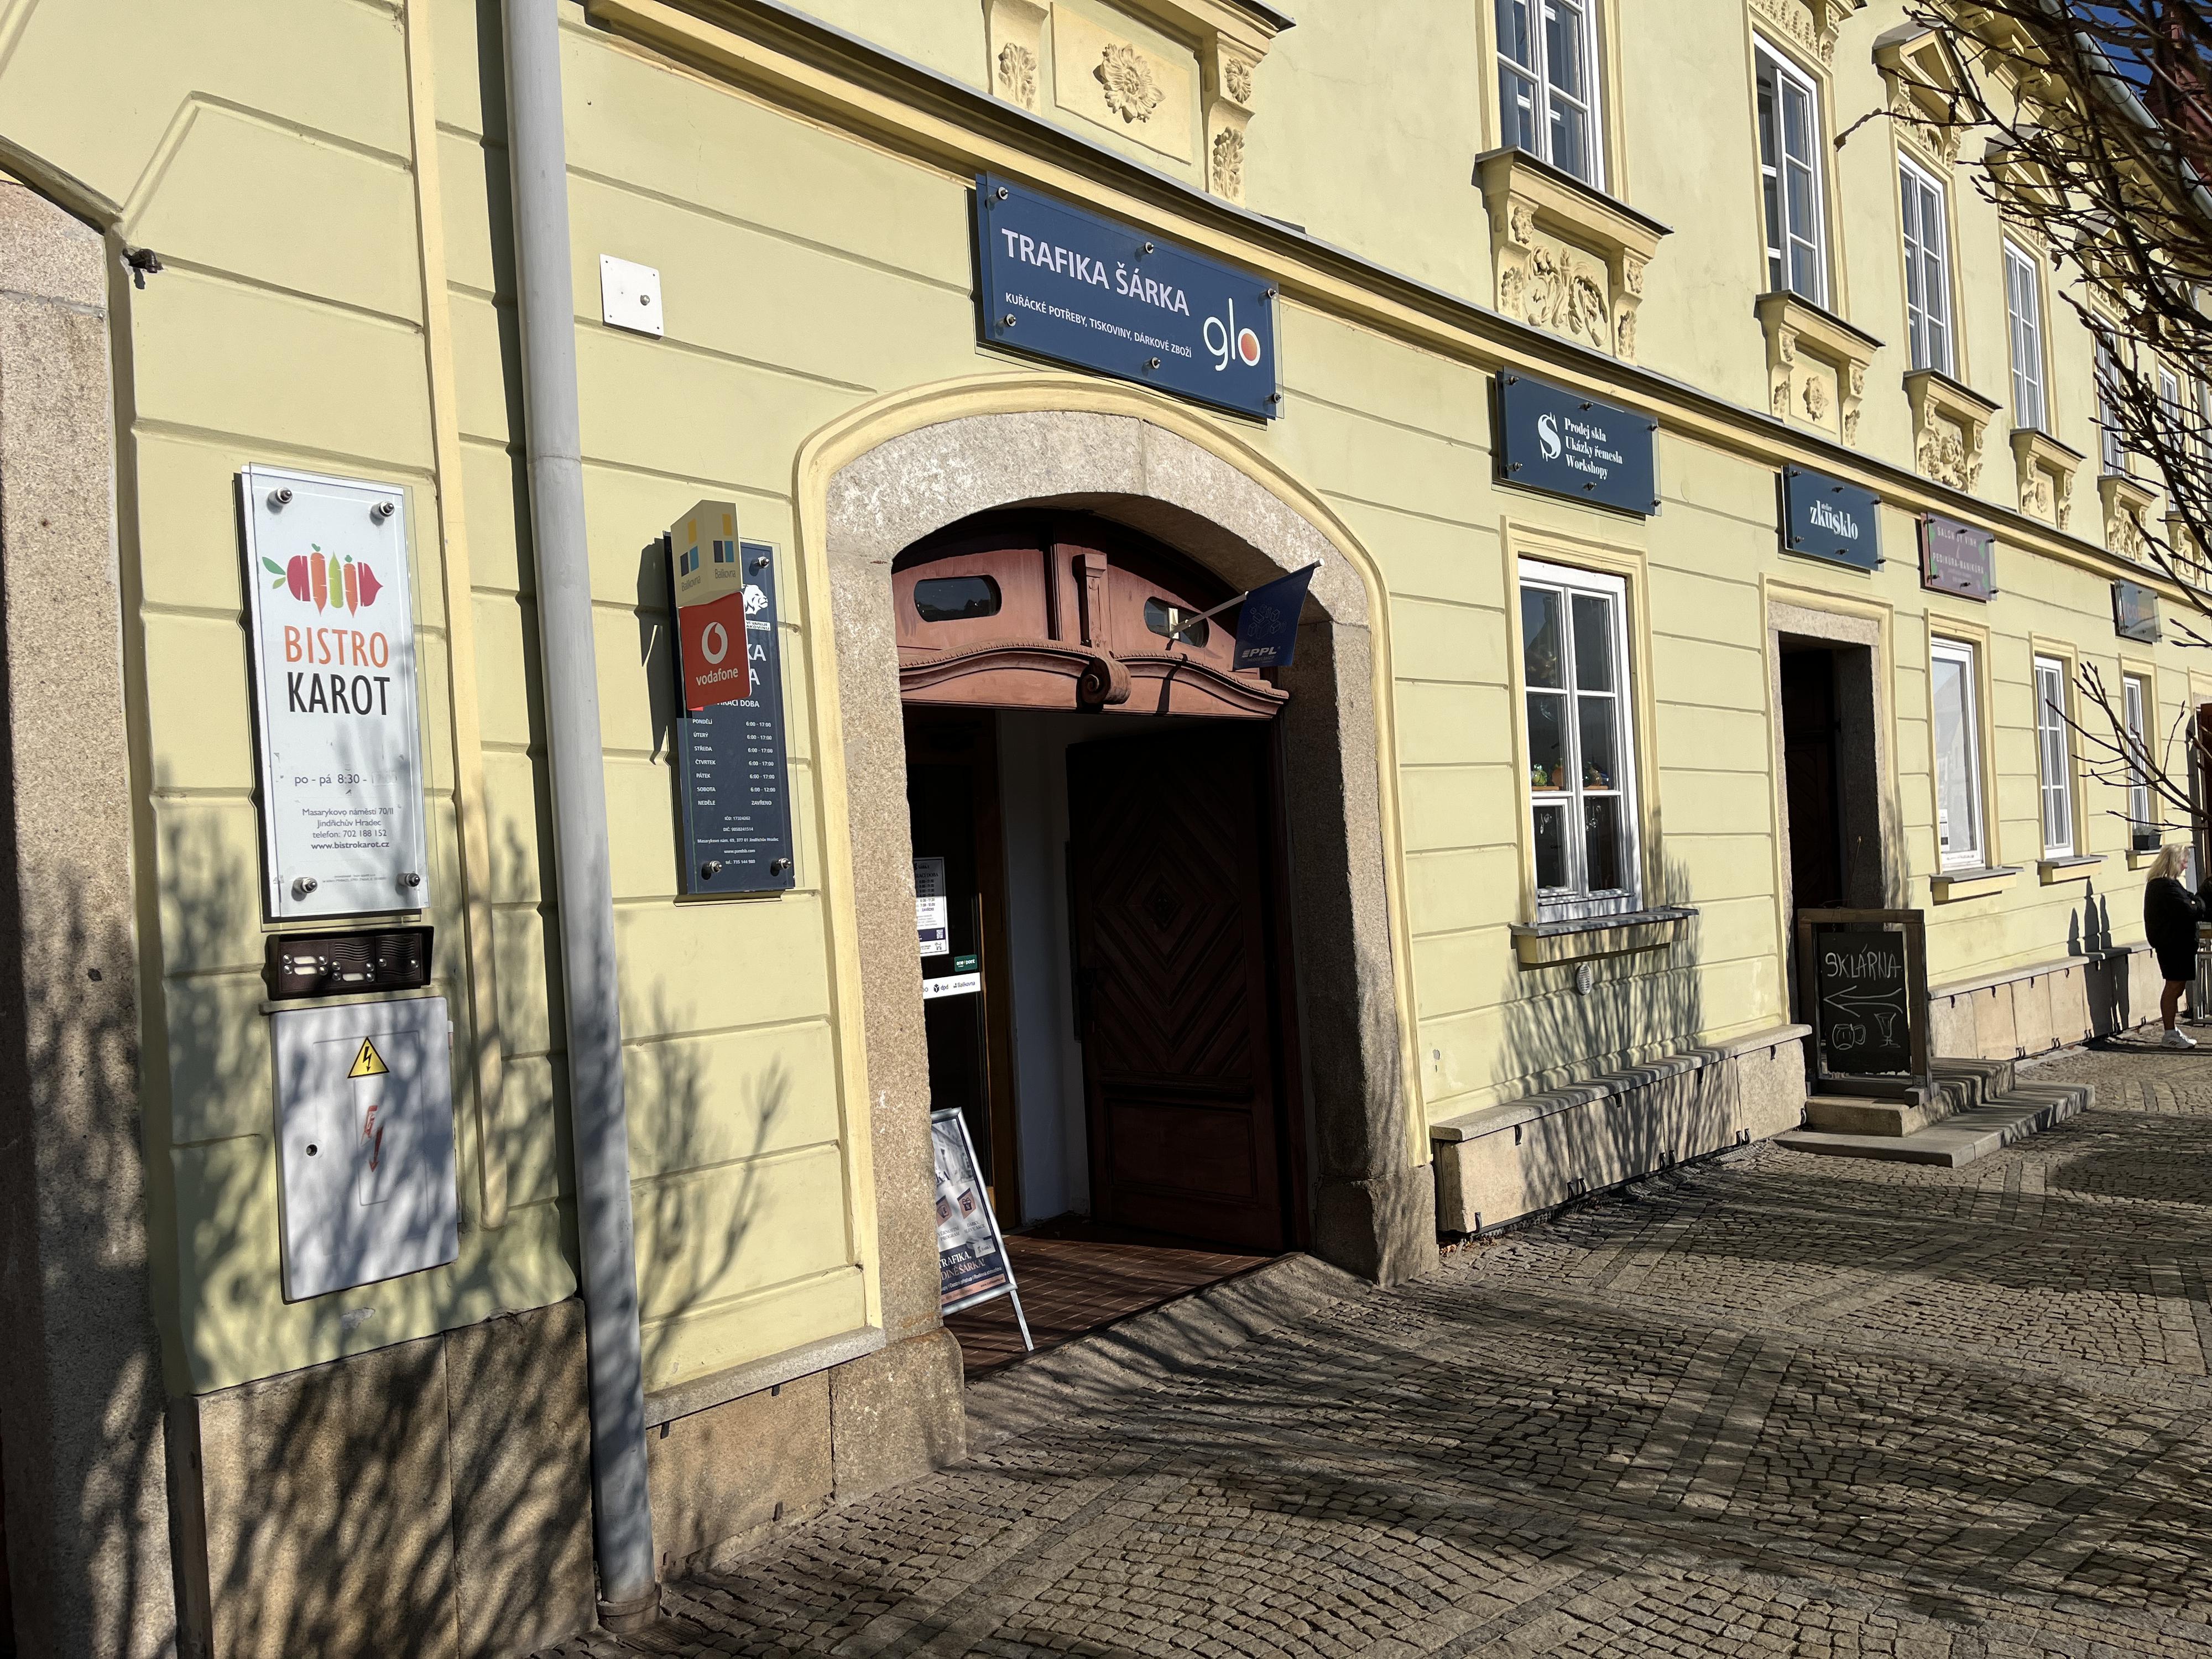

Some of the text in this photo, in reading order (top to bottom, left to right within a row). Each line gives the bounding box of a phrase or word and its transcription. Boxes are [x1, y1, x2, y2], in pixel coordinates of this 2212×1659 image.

[1001, 228, 1190, 316] TRAFIKA ŠÁRKA
[1005, 292, 1192, 358] KUŘÁCKÉ POTŘEBY, TISKOVINY, DÁRKOVÉ ZBOŽÍ
[1203, 298, 1261, 372] glo
[1564, 418, 1606, 442] Prodej skla
[1564, 435, 1623, 465] Ukázky řemesla
[1566, 454, 1609, 480] Workshopy
[1937, 526, 1954, 540] SALON
[284, 625, 388, 668] BISTRO
[696, 667, 738, 686] vodafone
[287, 671, 390, 716] KAROT
[740, 700, 760, 708] DOBA
[295, 776, 308, 786] po
[319, 774, 332, 786] pá
[337, 774, 359, 784] 8:30
[302, 808, 347, 817] Masarykovo
[317, 820, 353, 829] Jindřichův
[311, 841, 390, 849] www.bistrokarot.cz
[1825, 943, 1902, 981] SKLÁRNA
[940, 1232, 960, 1241] PROGRAM
[941, 1258, 985, 1280] DINĚ ŠÁRKA!
